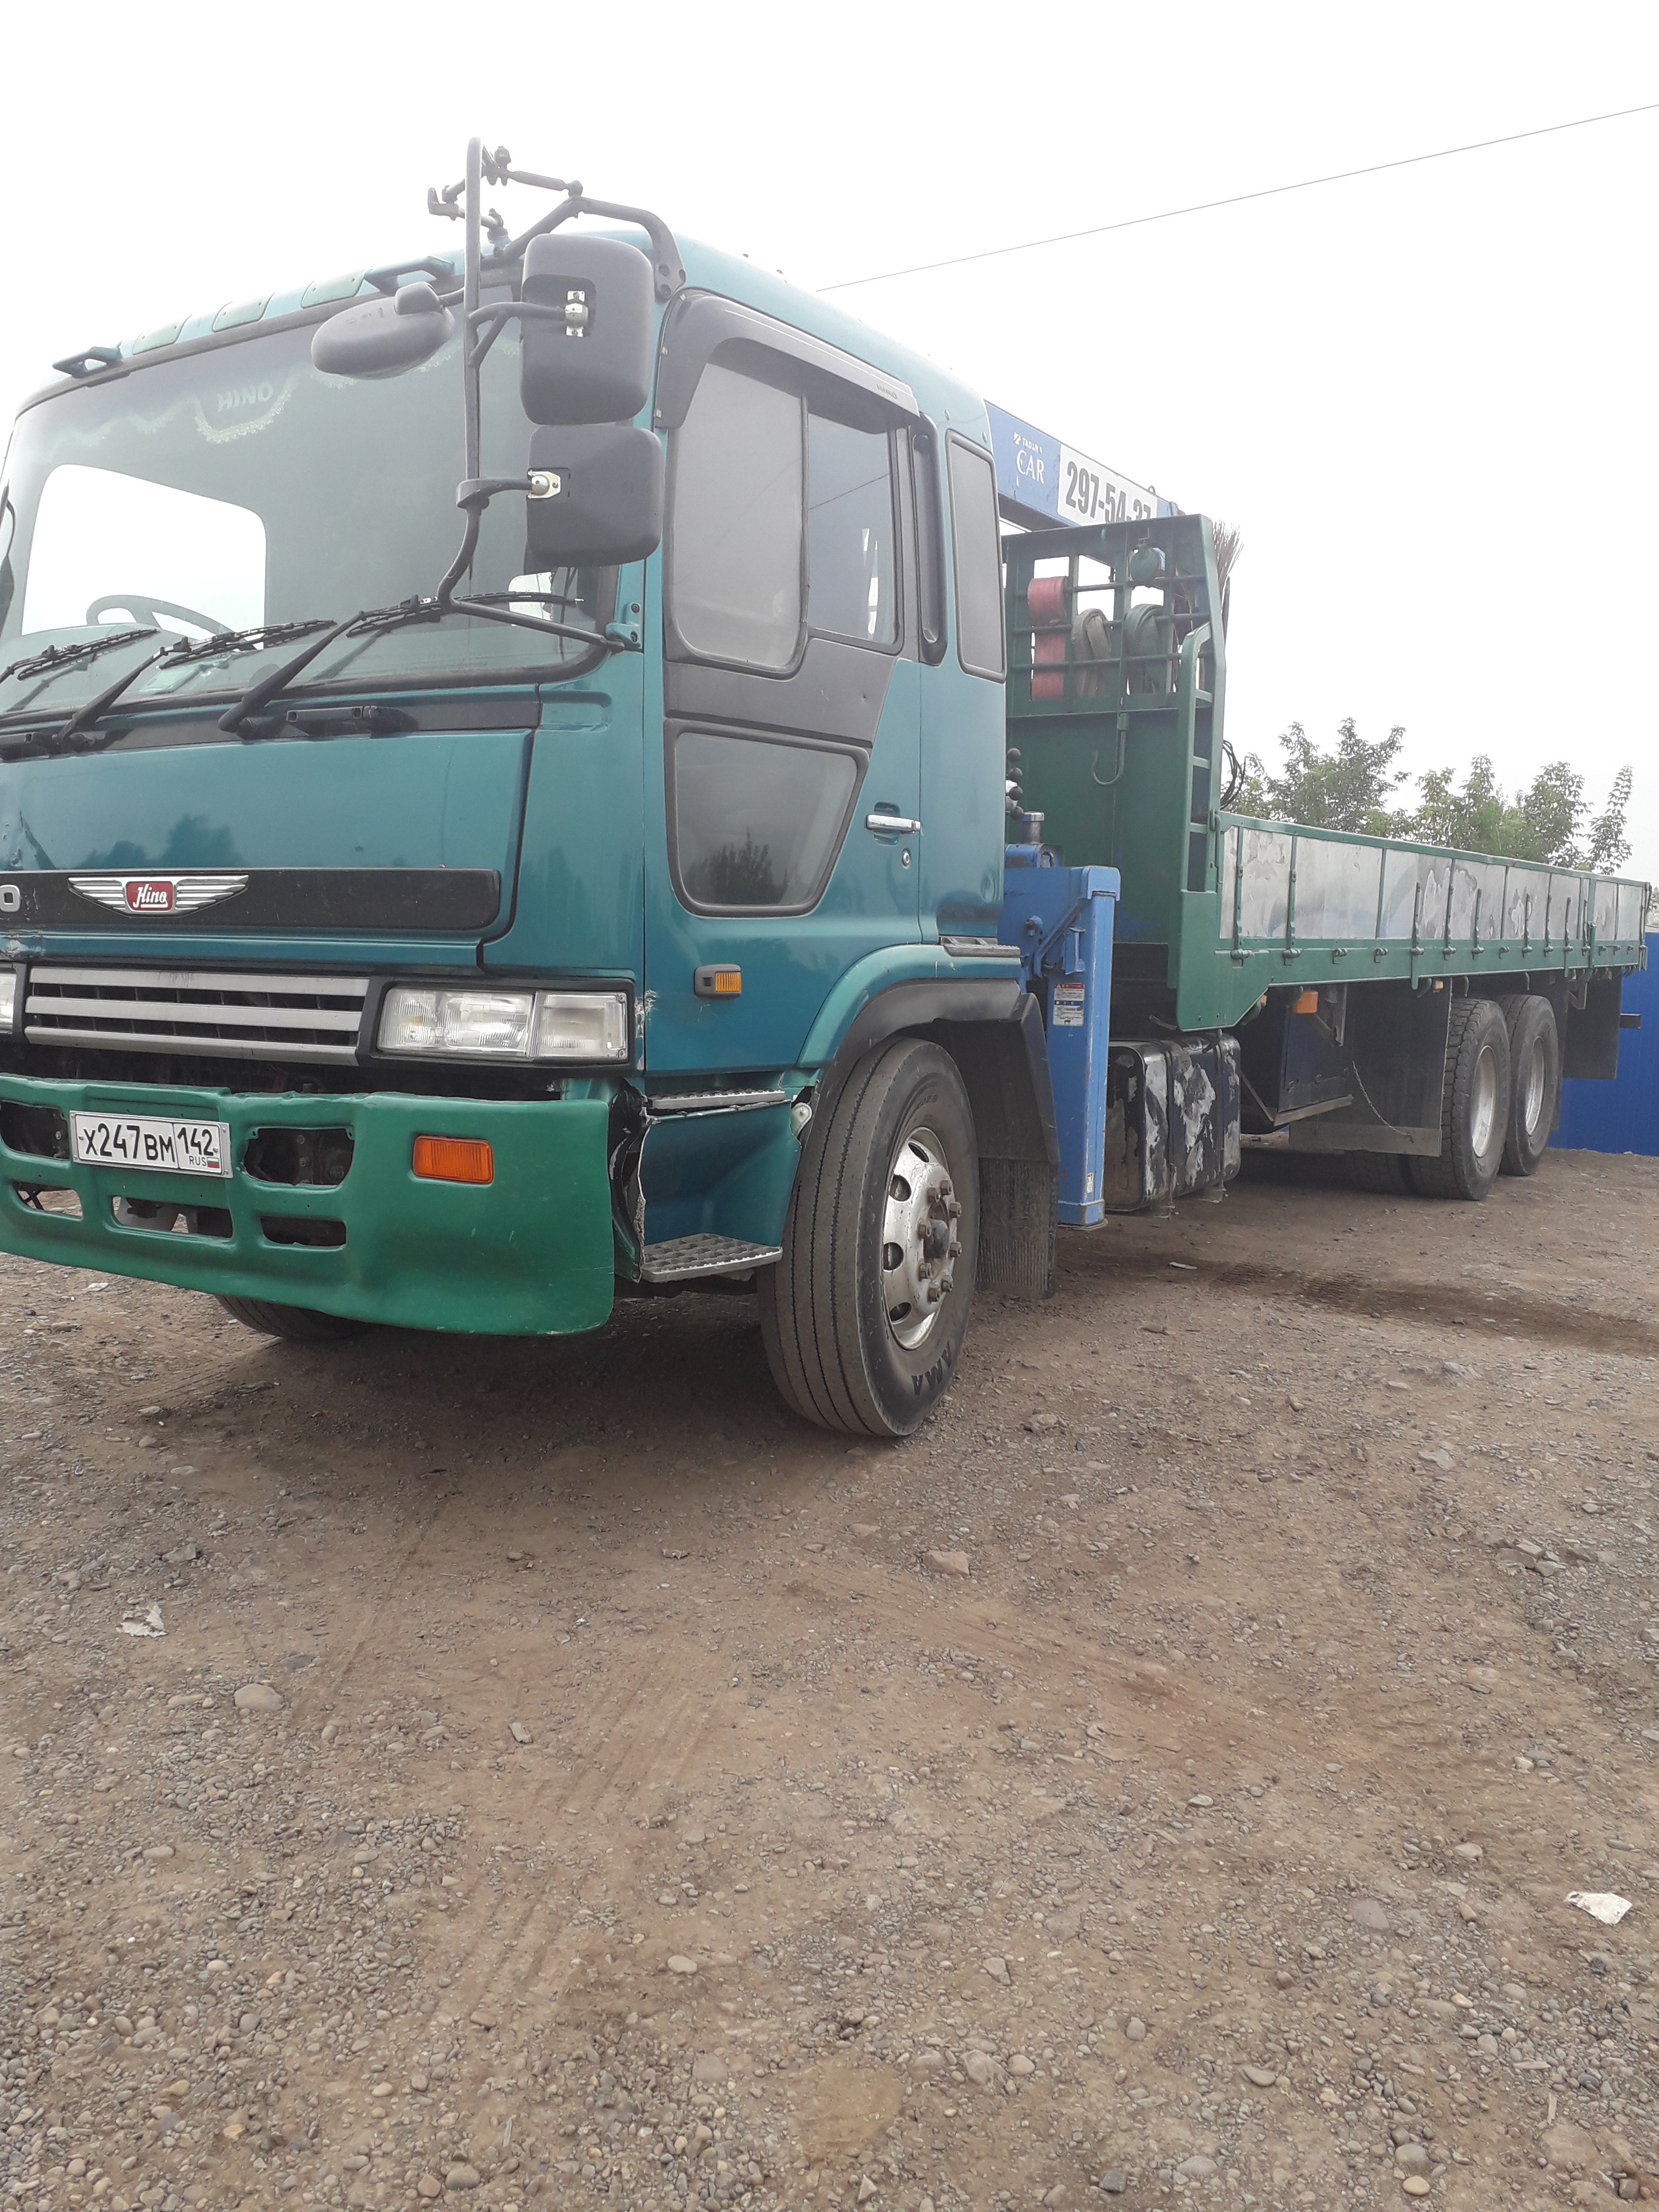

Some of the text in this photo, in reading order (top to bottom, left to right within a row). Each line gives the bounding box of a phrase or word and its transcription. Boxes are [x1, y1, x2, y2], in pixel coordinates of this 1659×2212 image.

[216, 382, 273, 413] HINO
[132, 884, 168, 908] Hino
[177, 1127, 214, 1156] 142
[189, 1155, 207, 1167] RUS
